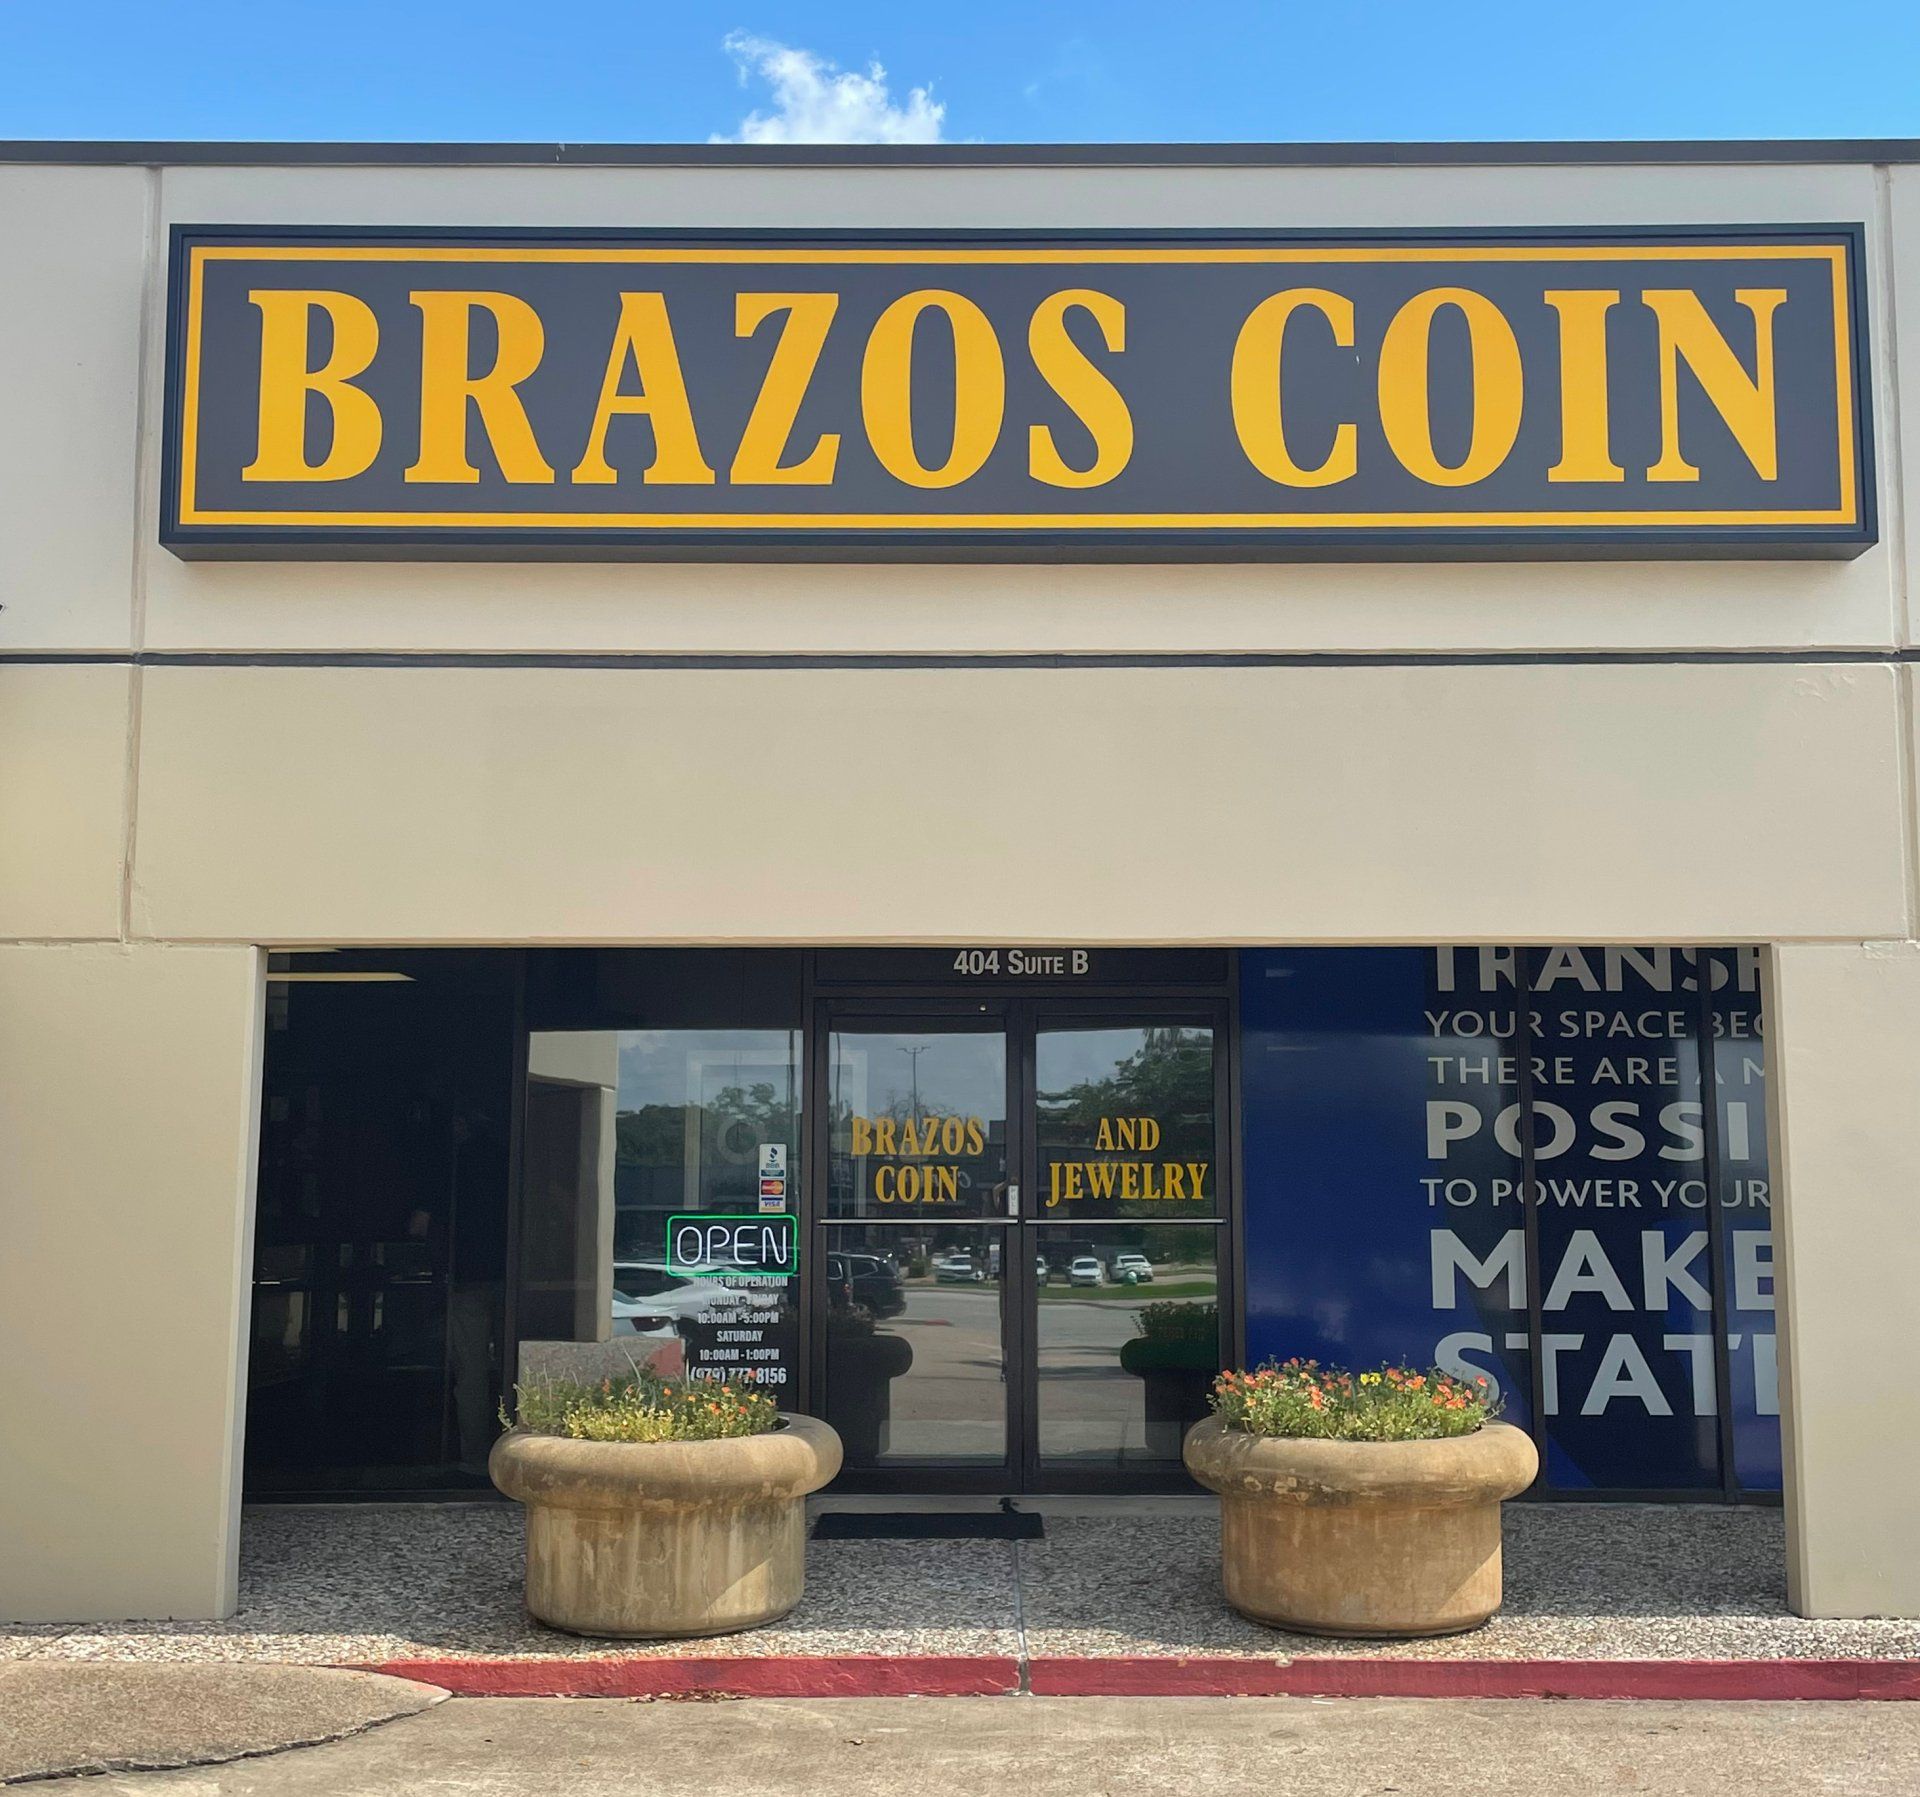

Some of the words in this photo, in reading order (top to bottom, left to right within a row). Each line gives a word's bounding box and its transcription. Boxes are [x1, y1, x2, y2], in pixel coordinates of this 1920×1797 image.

[242, 289, 1134, 488] BRAZOS
[1230, 287, 1787, 487] COIN
[953, 950, 1000, 974] 404
[1072, 950, 1089, 974] B
[1424, 1011, 1545, 1038] YOUR
[1559, 1011, 1687, 1038] SPACE
[1428, 1057, 1575, 1084] THERE
[1591, 1057, 1679, 1084] ARE
[851, 1115, 984, 1155] BRAZOS
[1095, 1117, 1161, 1151] AND
[1426, 1100, 1750, 1160] POSSI
[875, 1165, 959, 1203] COIN
[1045, 1162, 1208, 1208] JEWELRY
[1420, 1178, 1477, 1206] TO
[1492, 1178, 1642, 1207] POWER
[1651, 1179, 1771, 1208] YOUR
[676, 1226, 788, 1265] OPEN
[726, 1276, 738, 1287] OF
[739, 1276, 788, 1287] OPERATION
[1430, 1229, 1775, 1311] MAKE
[697, 1312, 737, 1324] 10:00AM
[716, 1330, 763, 1342] SATURDAY
[699, 1349, 739, 1361] 10:00AM
[746, 1348, 780, 1360] 1:00PM
[728, 1367, 787, 1384] 7778156
